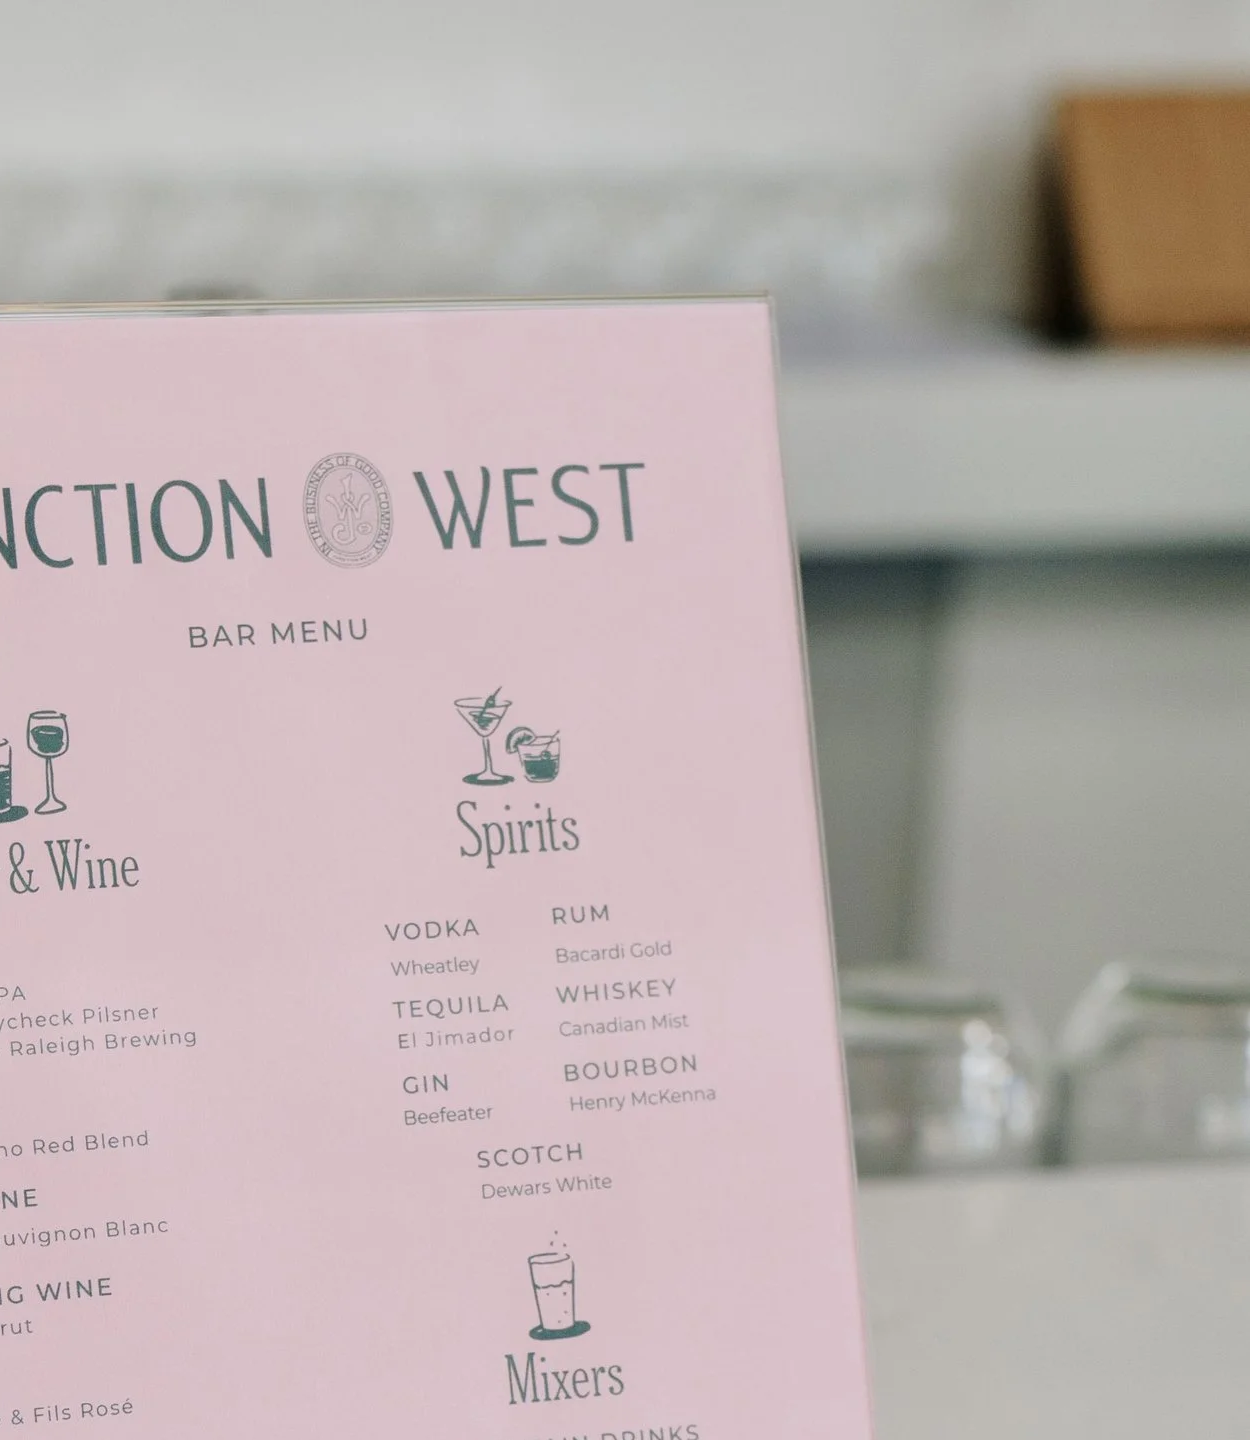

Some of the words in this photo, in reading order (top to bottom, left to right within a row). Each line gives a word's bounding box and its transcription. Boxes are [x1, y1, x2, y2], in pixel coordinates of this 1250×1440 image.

[318, 541, 332, 556] IN
[355, 458, 384, 489] GOOD
[373, 491, 391, 554] COMPANY
[413, 463, 645, 549] WEST
[189, 624, 255, 648] BAR
[271, 619, 367, 644] MENU
[457, 801, 579, 869] Spirits
[9, 842, 39, 894] &
[44, 839, 139, 891] Wine
[552, 905, 609, 924] RUM
[385, 919, 479, 941] VODKA
[556, 944, 625, 963] Bacardi
[630, 941, 672, 958] Gold
[391, 957, 479, 976] Wheatley
[556, 979, 675, 1003] WHISKEY
[83, 1007, 158, 1024] Pilsner
[392, 994, 508, 1019] TEQUILA
[559, 1017, 645, 1037] Canadian
[652, 1013, 689, 1030] Mist
[11, 1035, 94, 1056] Raleigh
[105, 1032, 196, 1049] Brewing
[398, 1033, 416, 1049] El
[426, 1027, 514, 1047] Jimador
[564, 1055, 696, 1081] BOURBON
[403, 1074, 448, 1094] GIN
[570, 1096, 625, 1112] Henry
[631, 1089, 716, 1106] McKenna
[405, 1107, 492, 1125] Beefeater
[33, 1136, 74, 1154] Red
[85, 1130, 148, 1150] Blend
[477, 1143, 582, 1168] SCOTCH
[482, 1182, 551, 1199] Dewars
[556, 1176, 612, 1192] White
[106, 1220, 168, 1237] Blanc
[36, 1278, 112, 1301] WINE
[505, 1352, 624, 1405] Mixers
[11, 1410, 24, 1425] &
[34, 1405, 71, 1422] Fils
[81, 1399, 132, 1418] Rosé
